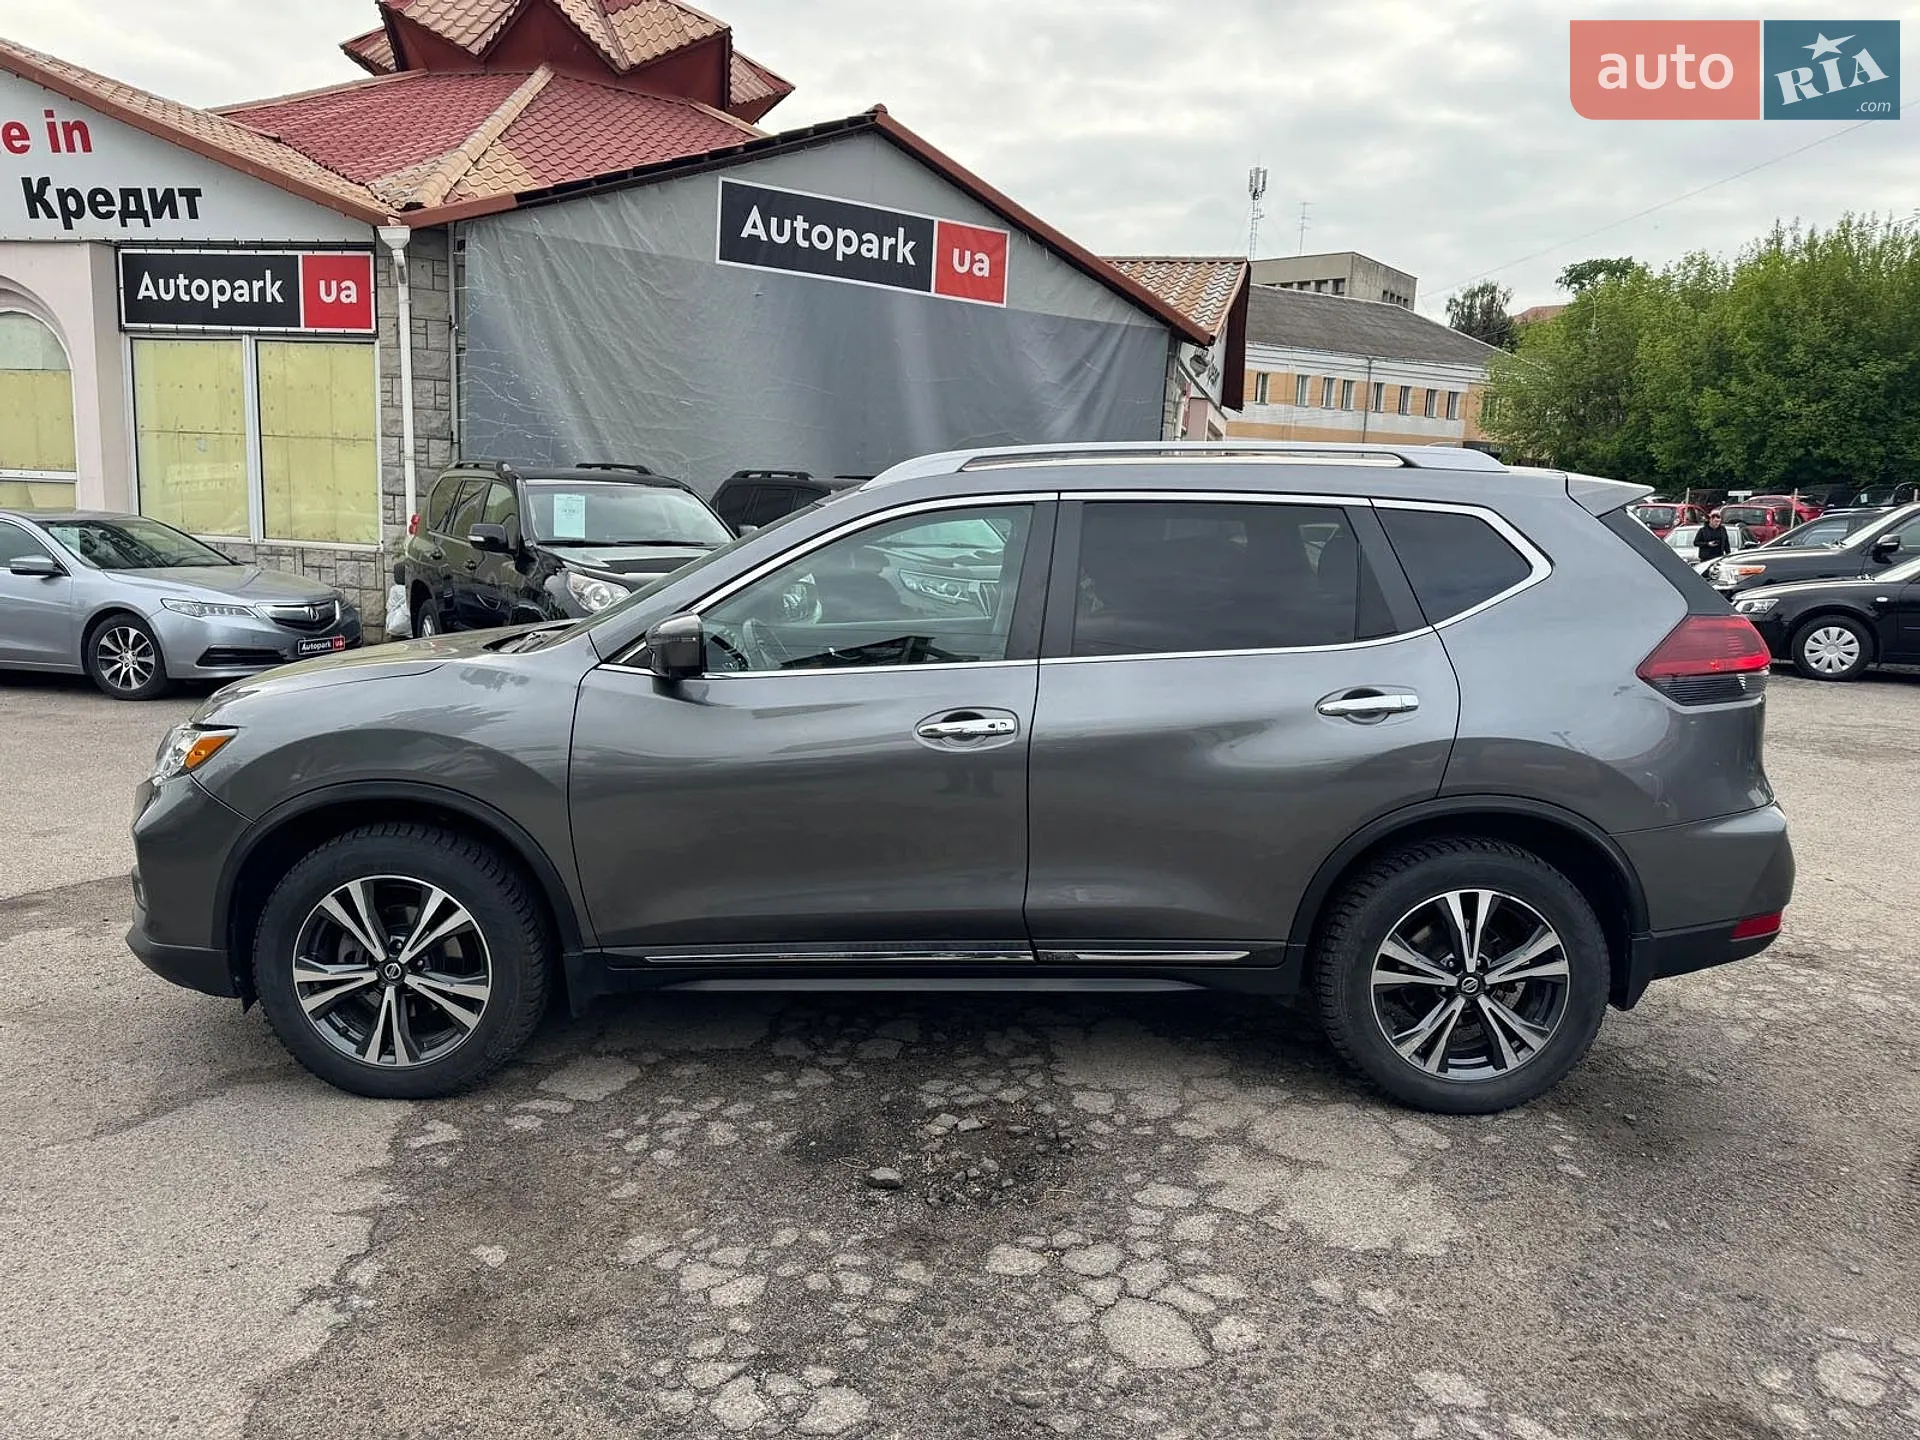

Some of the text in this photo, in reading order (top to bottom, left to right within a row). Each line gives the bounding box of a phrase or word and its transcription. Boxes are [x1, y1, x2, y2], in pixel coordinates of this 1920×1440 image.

[43, 109, 93, 153] in
[21, 176, 202, 230] Кредит
[740, 205, 990, 278] Autopark ua
[137, 269, 358, 308] Autopark ua
[301, 641, 331, 650] Autopark
